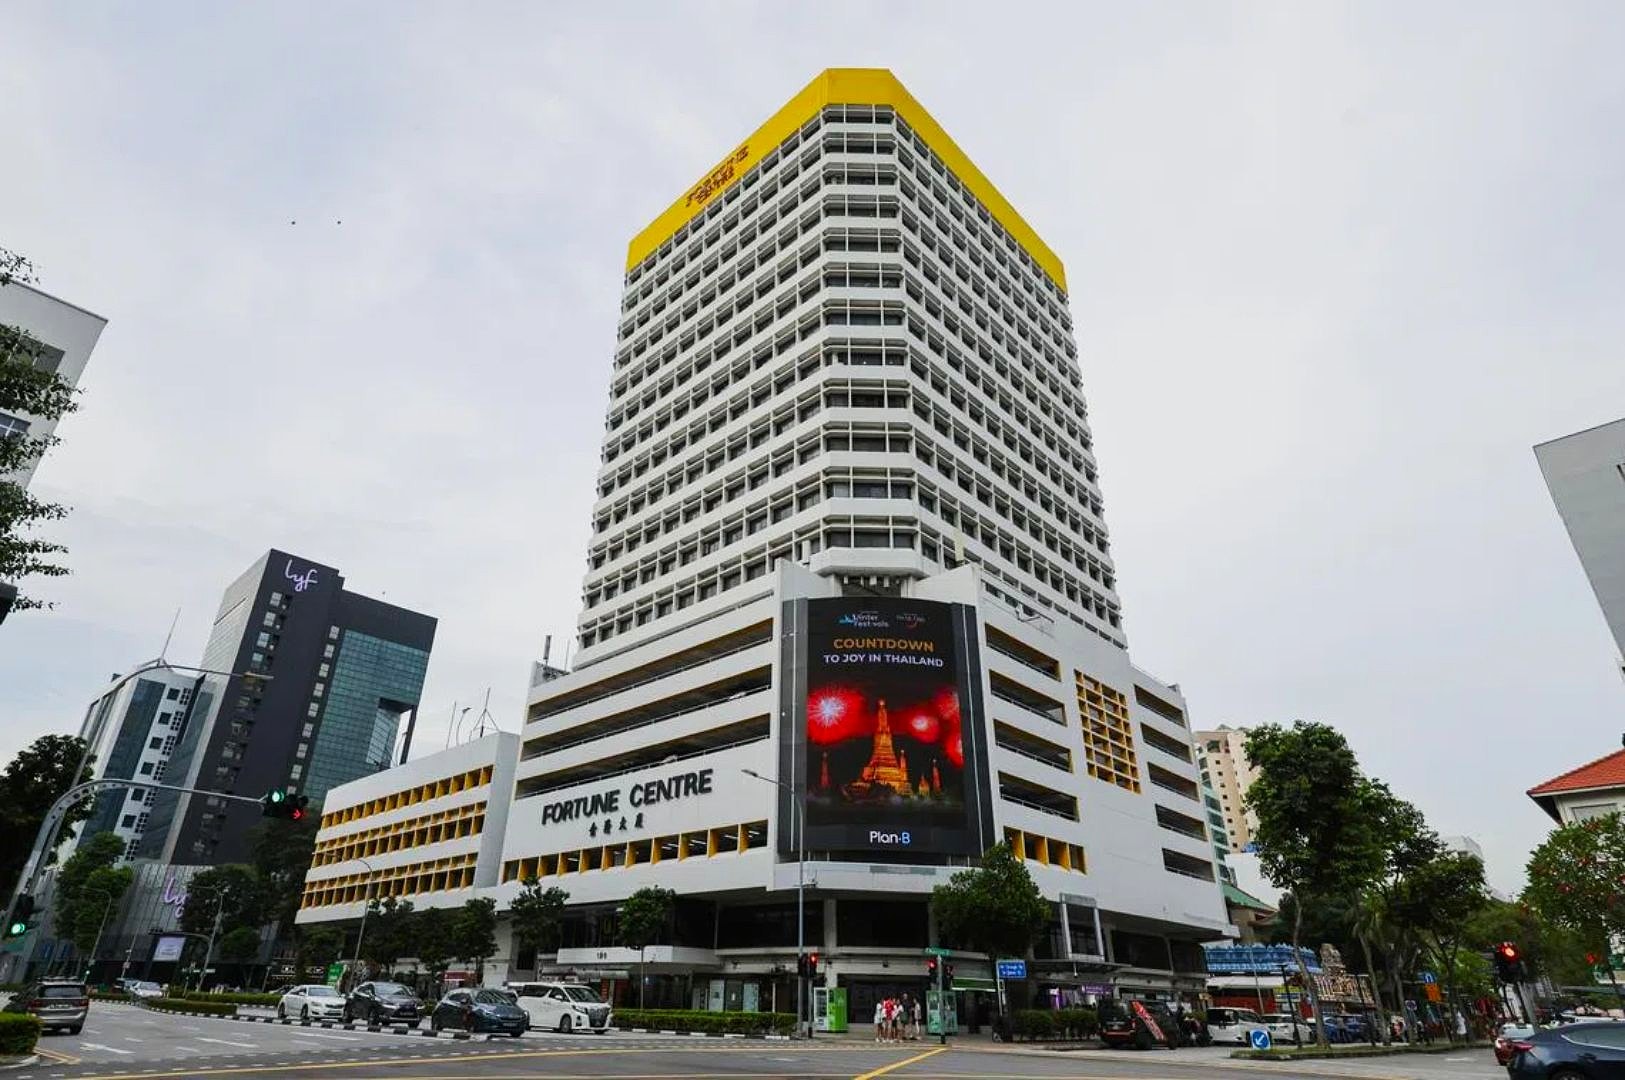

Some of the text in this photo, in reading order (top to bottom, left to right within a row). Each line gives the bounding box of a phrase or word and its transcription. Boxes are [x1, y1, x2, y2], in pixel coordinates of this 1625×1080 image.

[284, 559, 318, 592] lyf
[834, 638, 934, 652] COUNTDOWN
[823, 653, 944, 668] TO JOY IN THAILAND
[542, 769, 714, 826] FORTUNE CENTRE
